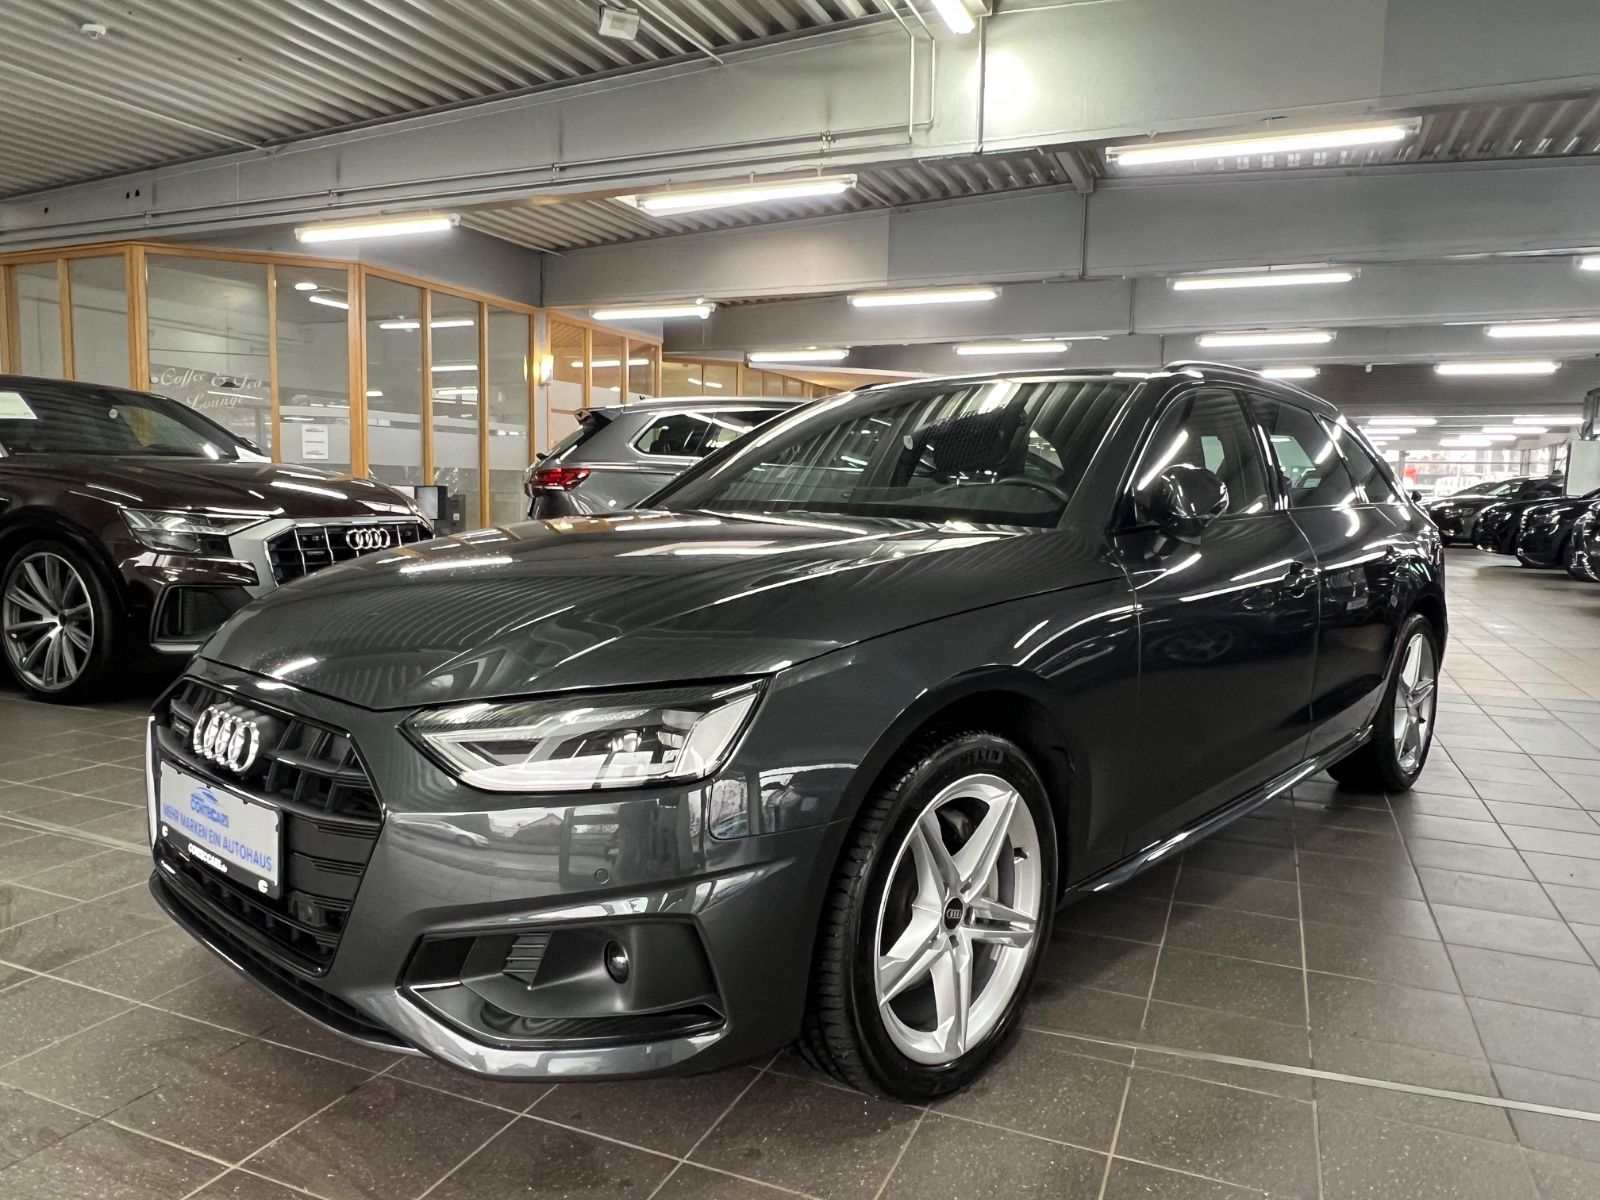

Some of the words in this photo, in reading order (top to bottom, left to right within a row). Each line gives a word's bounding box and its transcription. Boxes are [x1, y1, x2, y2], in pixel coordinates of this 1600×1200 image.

[161, 367, 206, 387] Coffee
[211, 373, 229, 387] &
[233, 373, 263, 390] Tea
[187, 393, 243, 409] Lounge
[180, 813, 209, 842] MARKEN
[208, 829, 222, 849] EIN
[223, 836, 272, 872] AUTOHAUS
